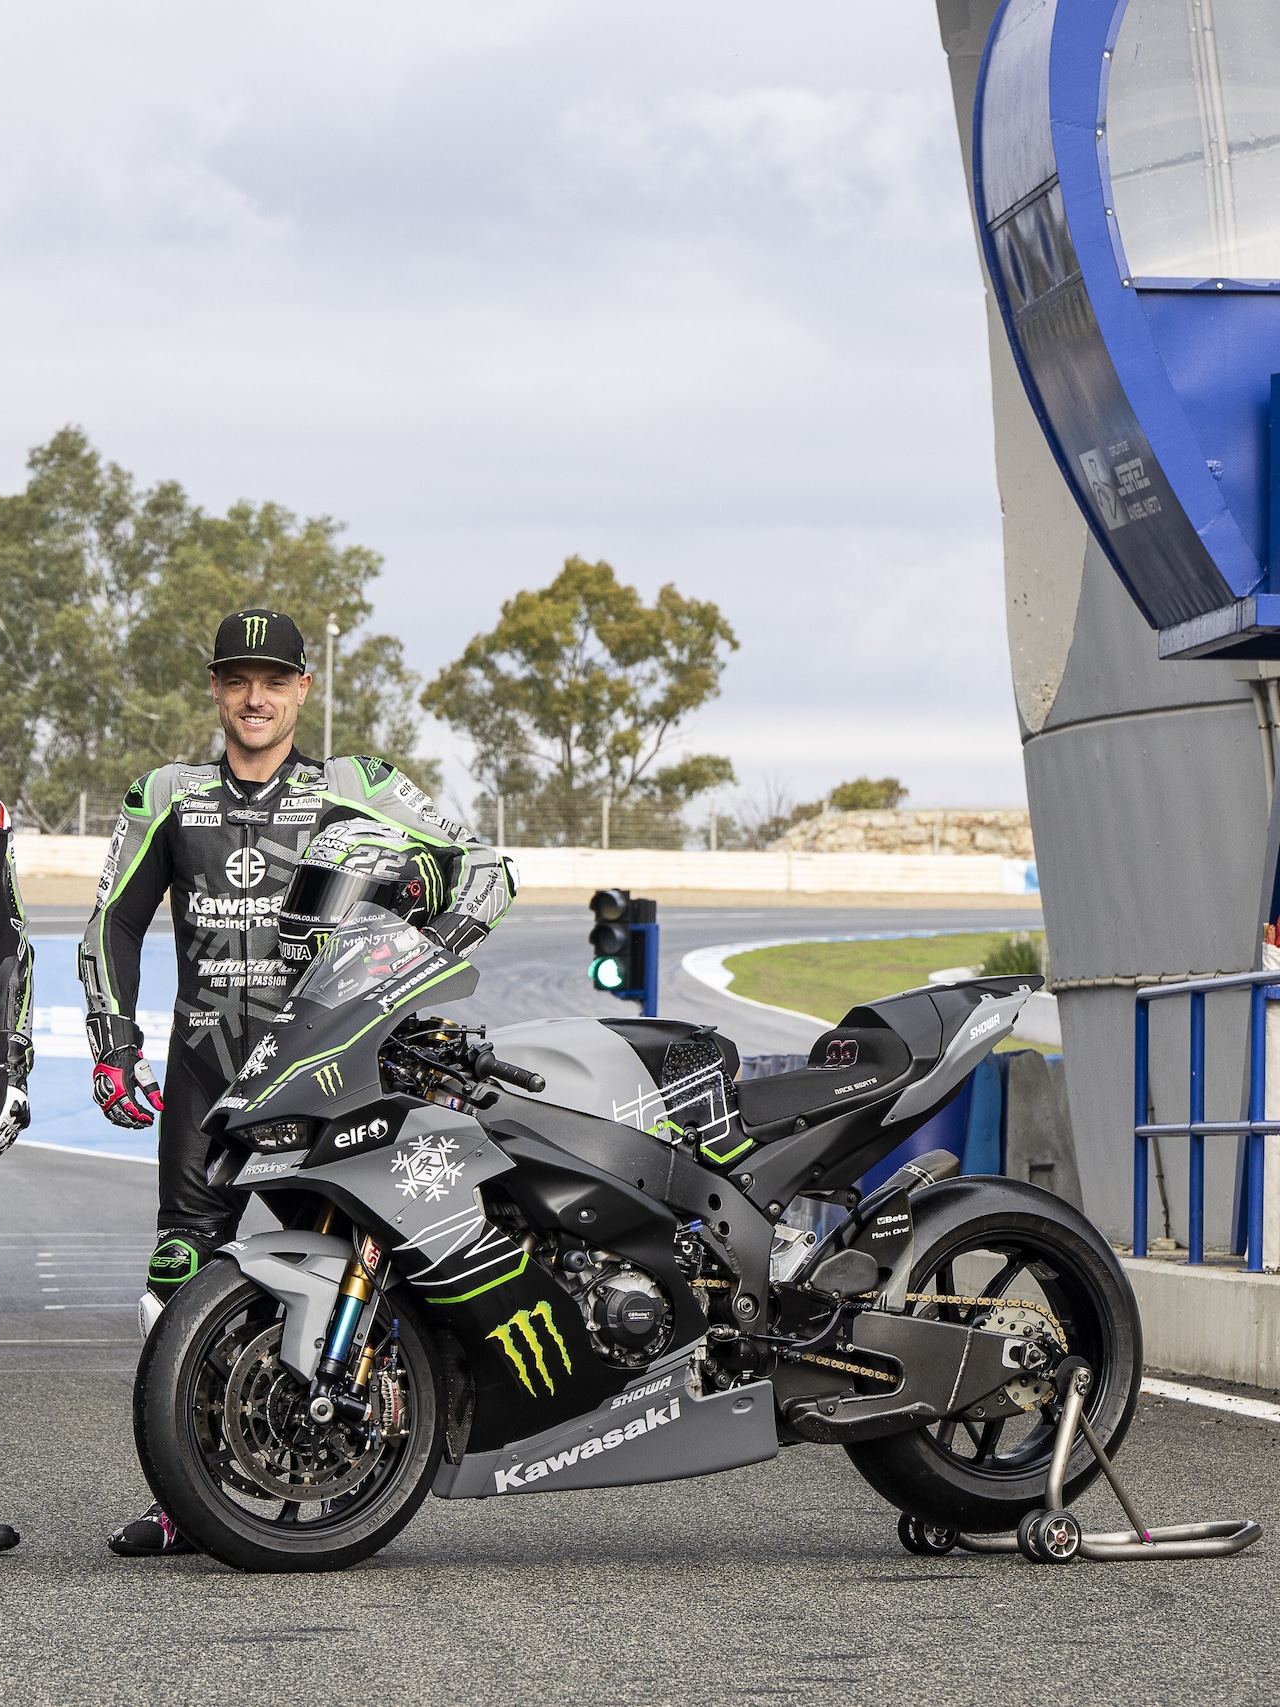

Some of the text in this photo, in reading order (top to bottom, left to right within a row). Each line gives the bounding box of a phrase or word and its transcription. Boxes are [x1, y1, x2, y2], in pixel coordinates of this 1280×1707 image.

[176, 788, 210, 797] SHARK
[195, 815, 219, 824] JUTA
[277, 815, 314, 823] SHOWA
[344, 846, 408, 881] 22
[197, 916, 250, 931] Racing
[210, 976, 227, 988] FUEL
[252, 975, 287, 987] PASSION
[378, 957, 448, 1010] Kawasaki
[970, 1013, 1001, 1040] SHOWA
[854, 1077, 878, 1090] SEATS
[334, 1124, 367, 1148] elf
[885, 1214, 909, 1224] Beta
[871, 1231, 892, 1239] Mark
[610, 1375, 673, 1411] SHOWA
[494, 1397, 682, 1494] Kawasaki
